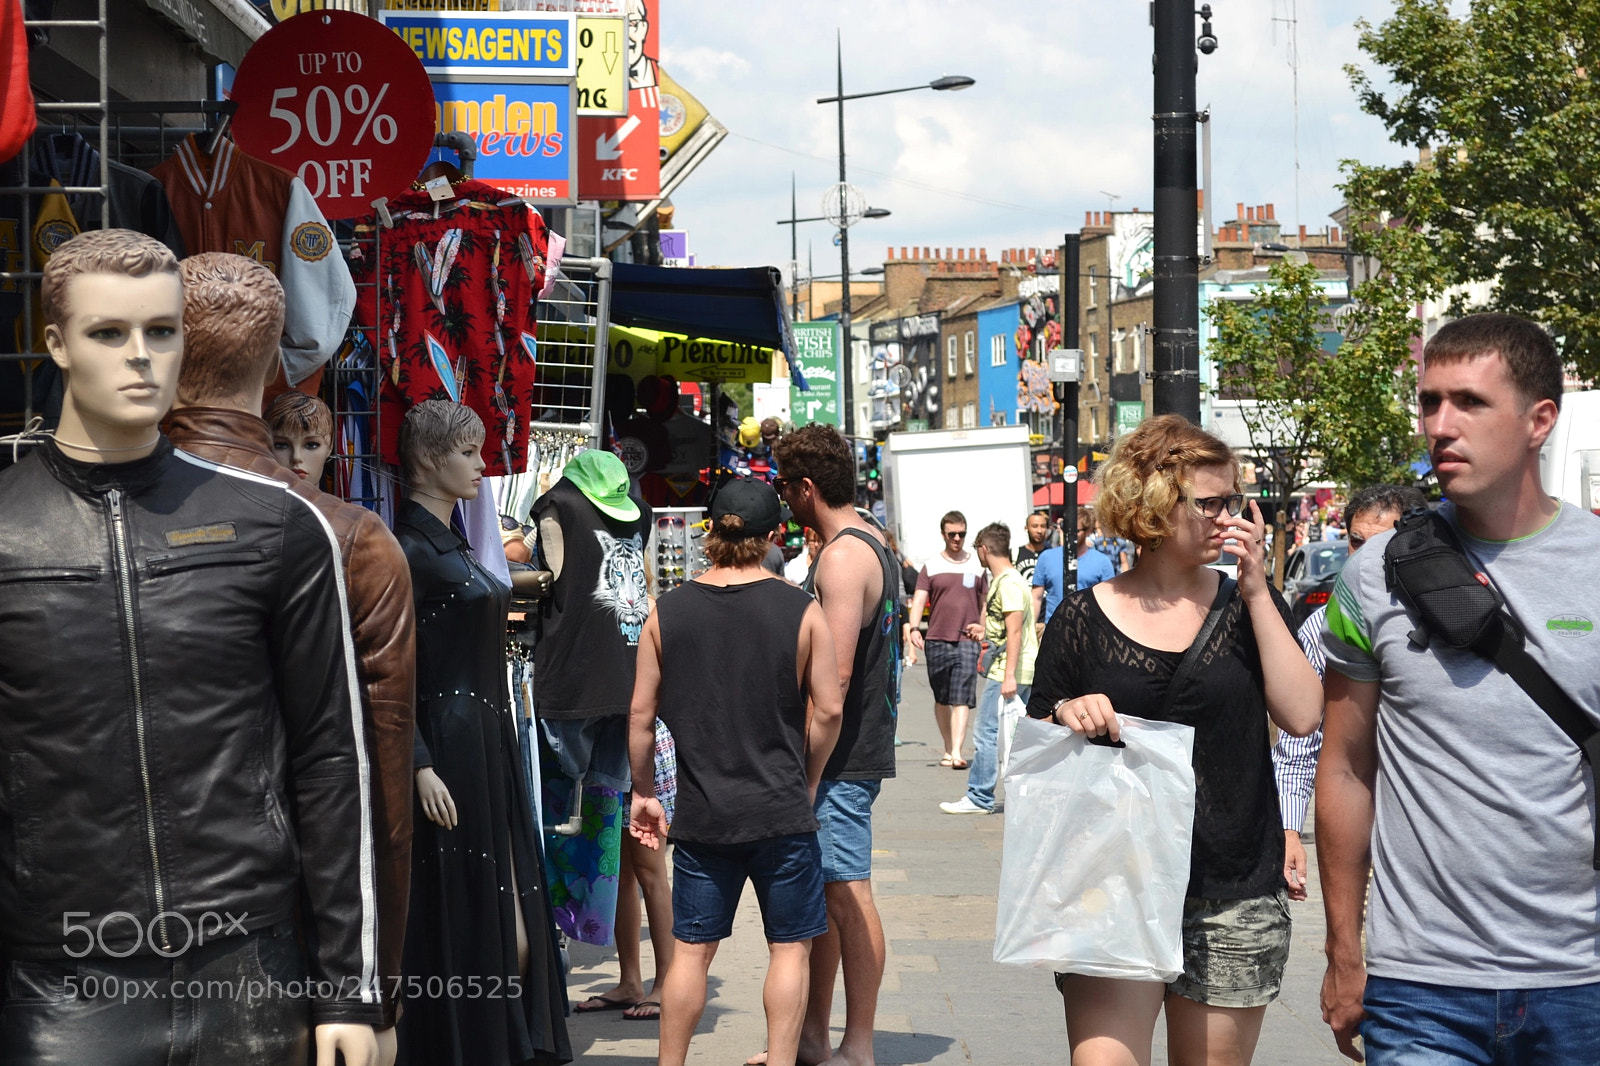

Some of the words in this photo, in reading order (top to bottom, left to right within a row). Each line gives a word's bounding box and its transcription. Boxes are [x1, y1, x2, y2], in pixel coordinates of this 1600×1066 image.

[298, 53, 327, 75] UP
[332, 51, 362, 73] TO
[269, 83, 398, 154] 50%
[435, 94, 557, 137] mden
[454, 131, 563, 157] ews
[297, 159, 372, 199] OFF
[601, 168, 638, 181] KFC
[496, 184, 557, 197] azines
[793, 328, 832, 337] BRITISH
[795, 336, 832, 350] FISH
[804, 350, 833, 358] CHIPS
